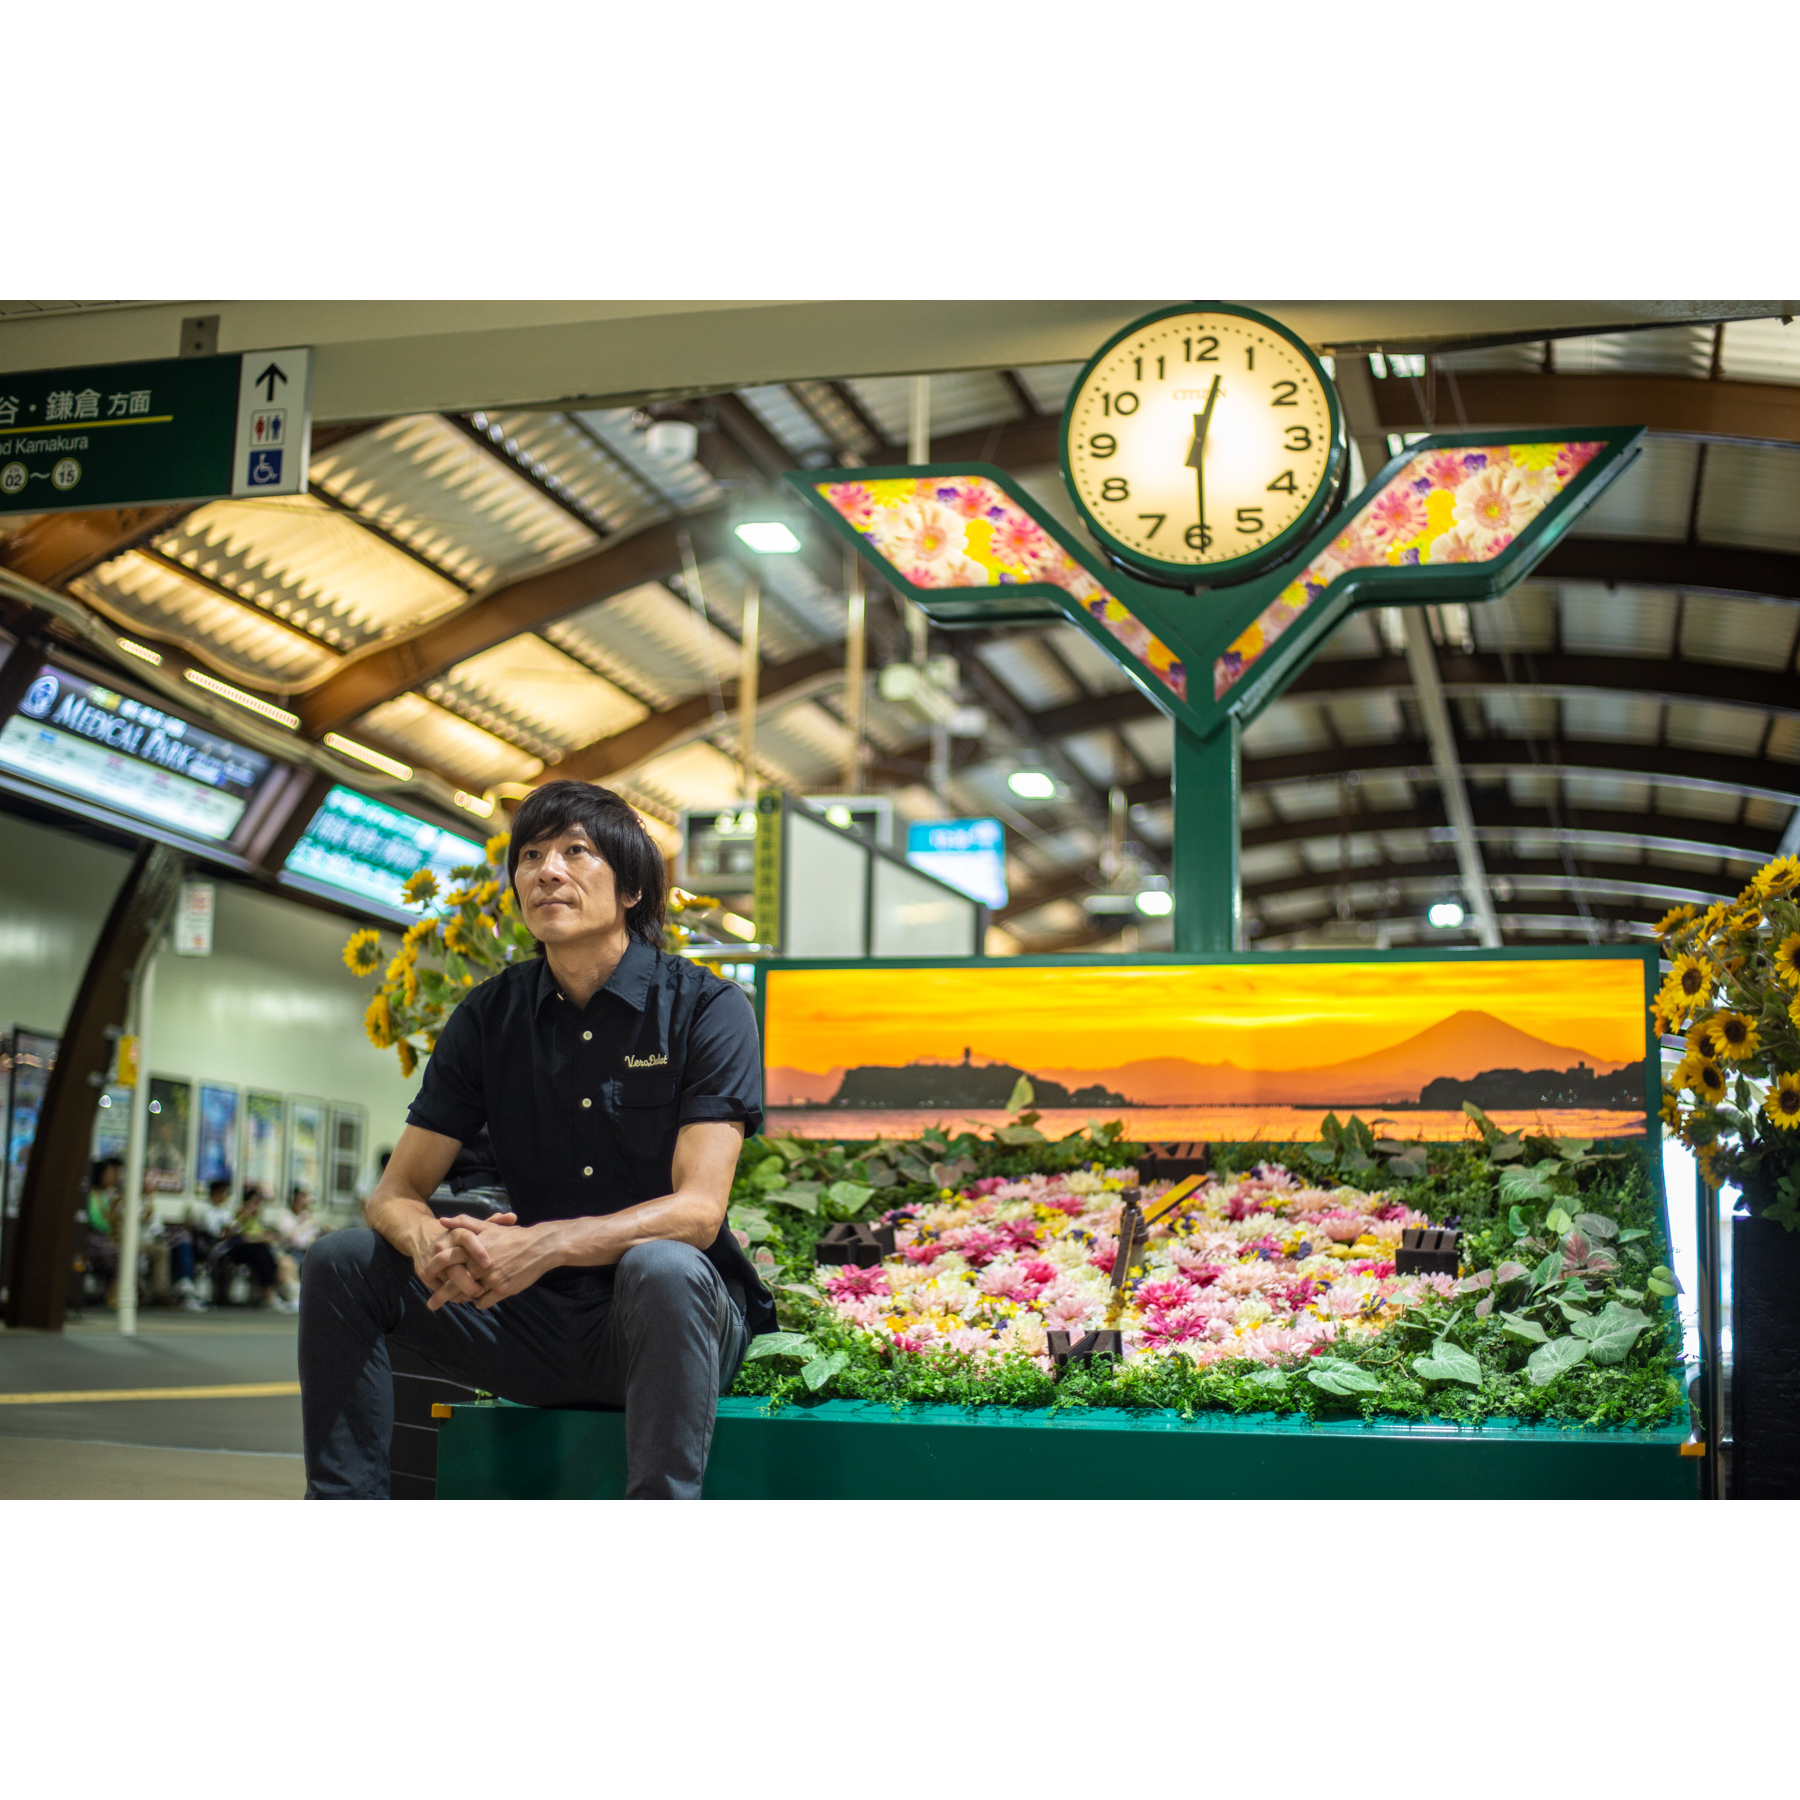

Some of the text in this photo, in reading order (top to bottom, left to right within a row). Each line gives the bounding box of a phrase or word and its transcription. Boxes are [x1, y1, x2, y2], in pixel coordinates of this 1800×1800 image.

[1183, 336, 1220, 362] 12
[1246, 346, 1255, 371] 1
[1134, 356, 1165, 381] 11
[107, 390, 152, 416] 方面
[1101, 391, 1139, 416] 10
[1271, 381, 1298, 406] 2
[16, 435, 89, 454] Kamakura
[1090, 433, 1117, 458] 9
[1284, 425, 1312, 451] 3
[5, 475, 22, 487] 02
[59, 470, 75, 483] 15
[1101, 477, 1129, 502] 8
[1266, 470, 1298, 495] 4
[1138, 514, 1166, 539] 7
[1236, 507, 1264, 533] 5
[1184, 523, 1213, 550] 6
[51, 693, 145, 754] MEDICAL
[141, 728, 196, 773] PARK
